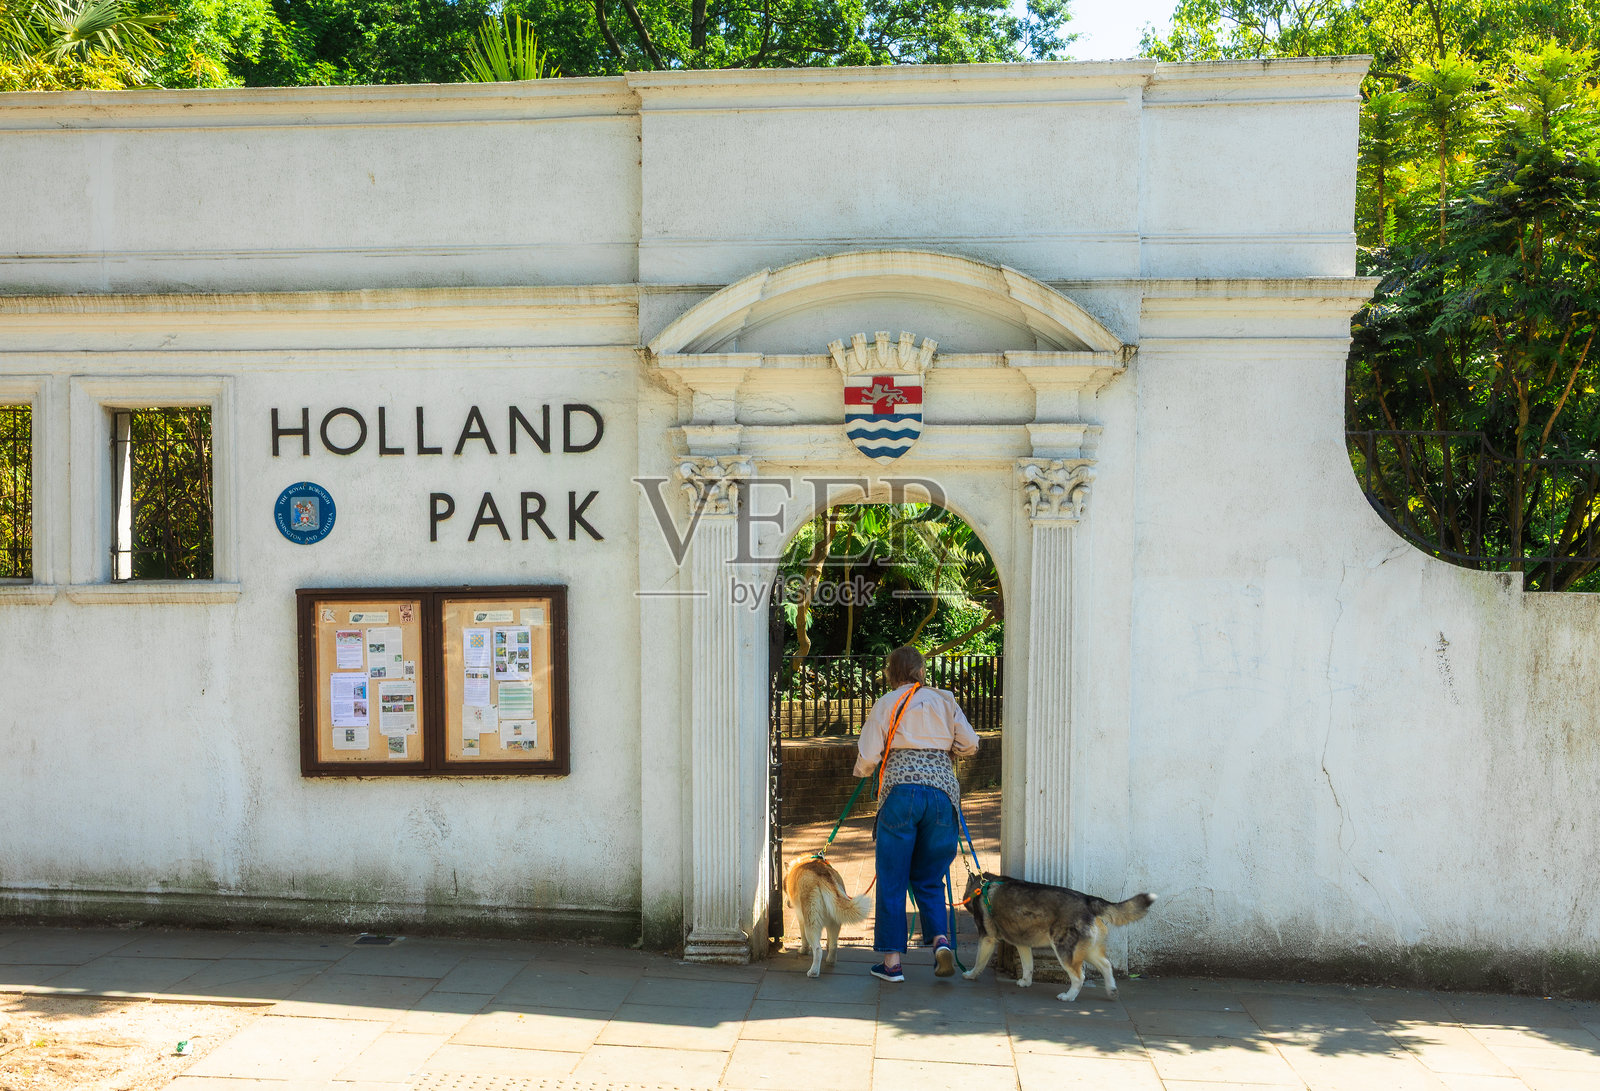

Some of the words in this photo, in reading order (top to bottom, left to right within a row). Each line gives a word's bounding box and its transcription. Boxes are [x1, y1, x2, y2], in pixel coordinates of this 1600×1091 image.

[271, 404, 604, 456] HOLLAND
[279, 495, 288, 505] THE
[288, 486, 305, 495] ROYAL
[309, 486, 331, 505] BOROUGH
[277, 512, 302, 541] KENSINGTON
[320, 512, 334, 535] CHELSEA
[430, 491, 604, 542] PARK
